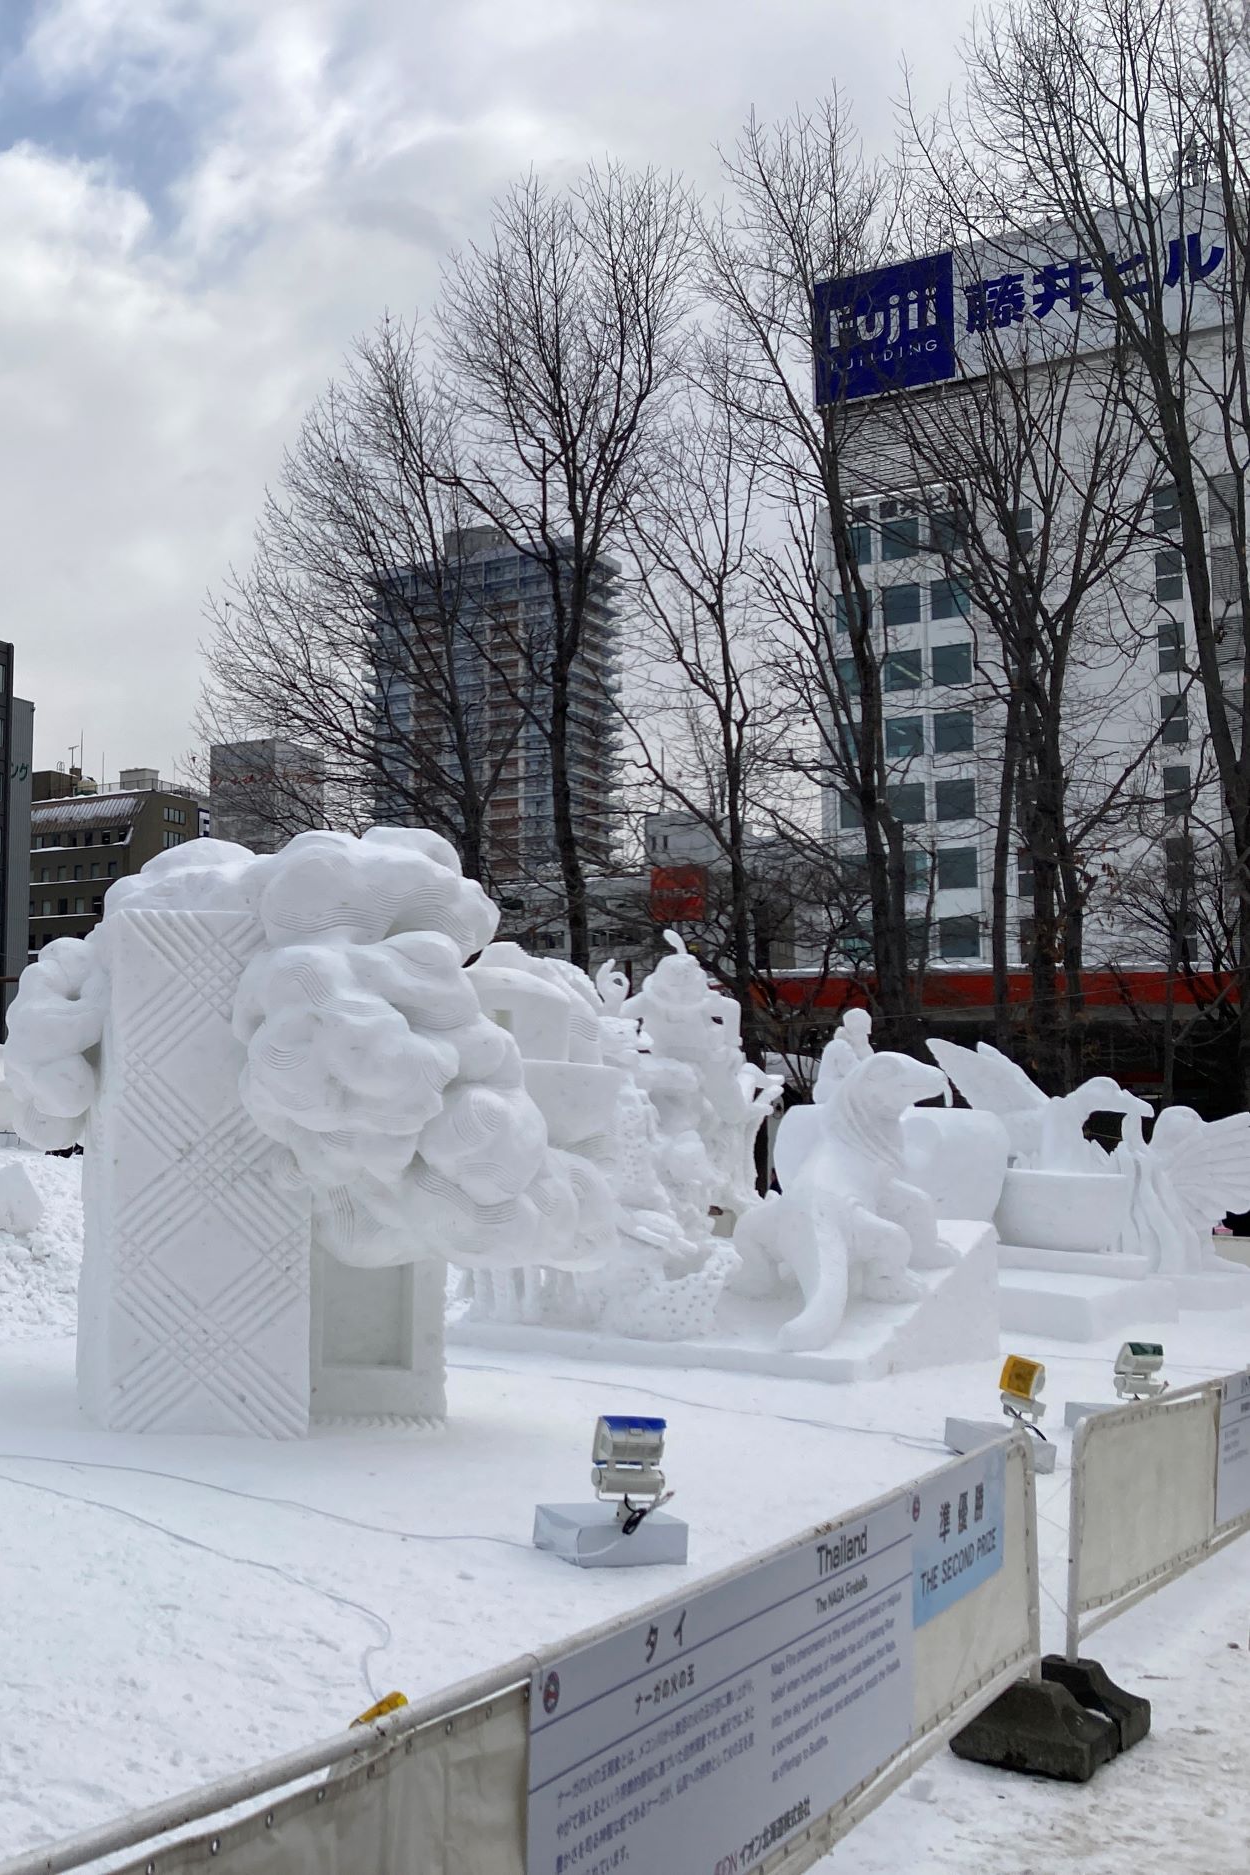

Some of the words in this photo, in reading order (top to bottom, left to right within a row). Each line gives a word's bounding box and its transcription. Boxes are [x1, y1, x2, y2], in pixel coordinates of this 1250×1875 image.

[829, 286, 937, 349] Fujii
[939, 1482, 984, 1543] 準優勝
[816, 1524, 868, 1576] Thailand
[920, 1565, 939, 1598] THE
[941, 1542, 975, 1584] SECOND
[976, 1527, 997, 1561] PRIZE
[815, 1596, 828, 1614] The
[646, 1609, 686, 1663] タイ
